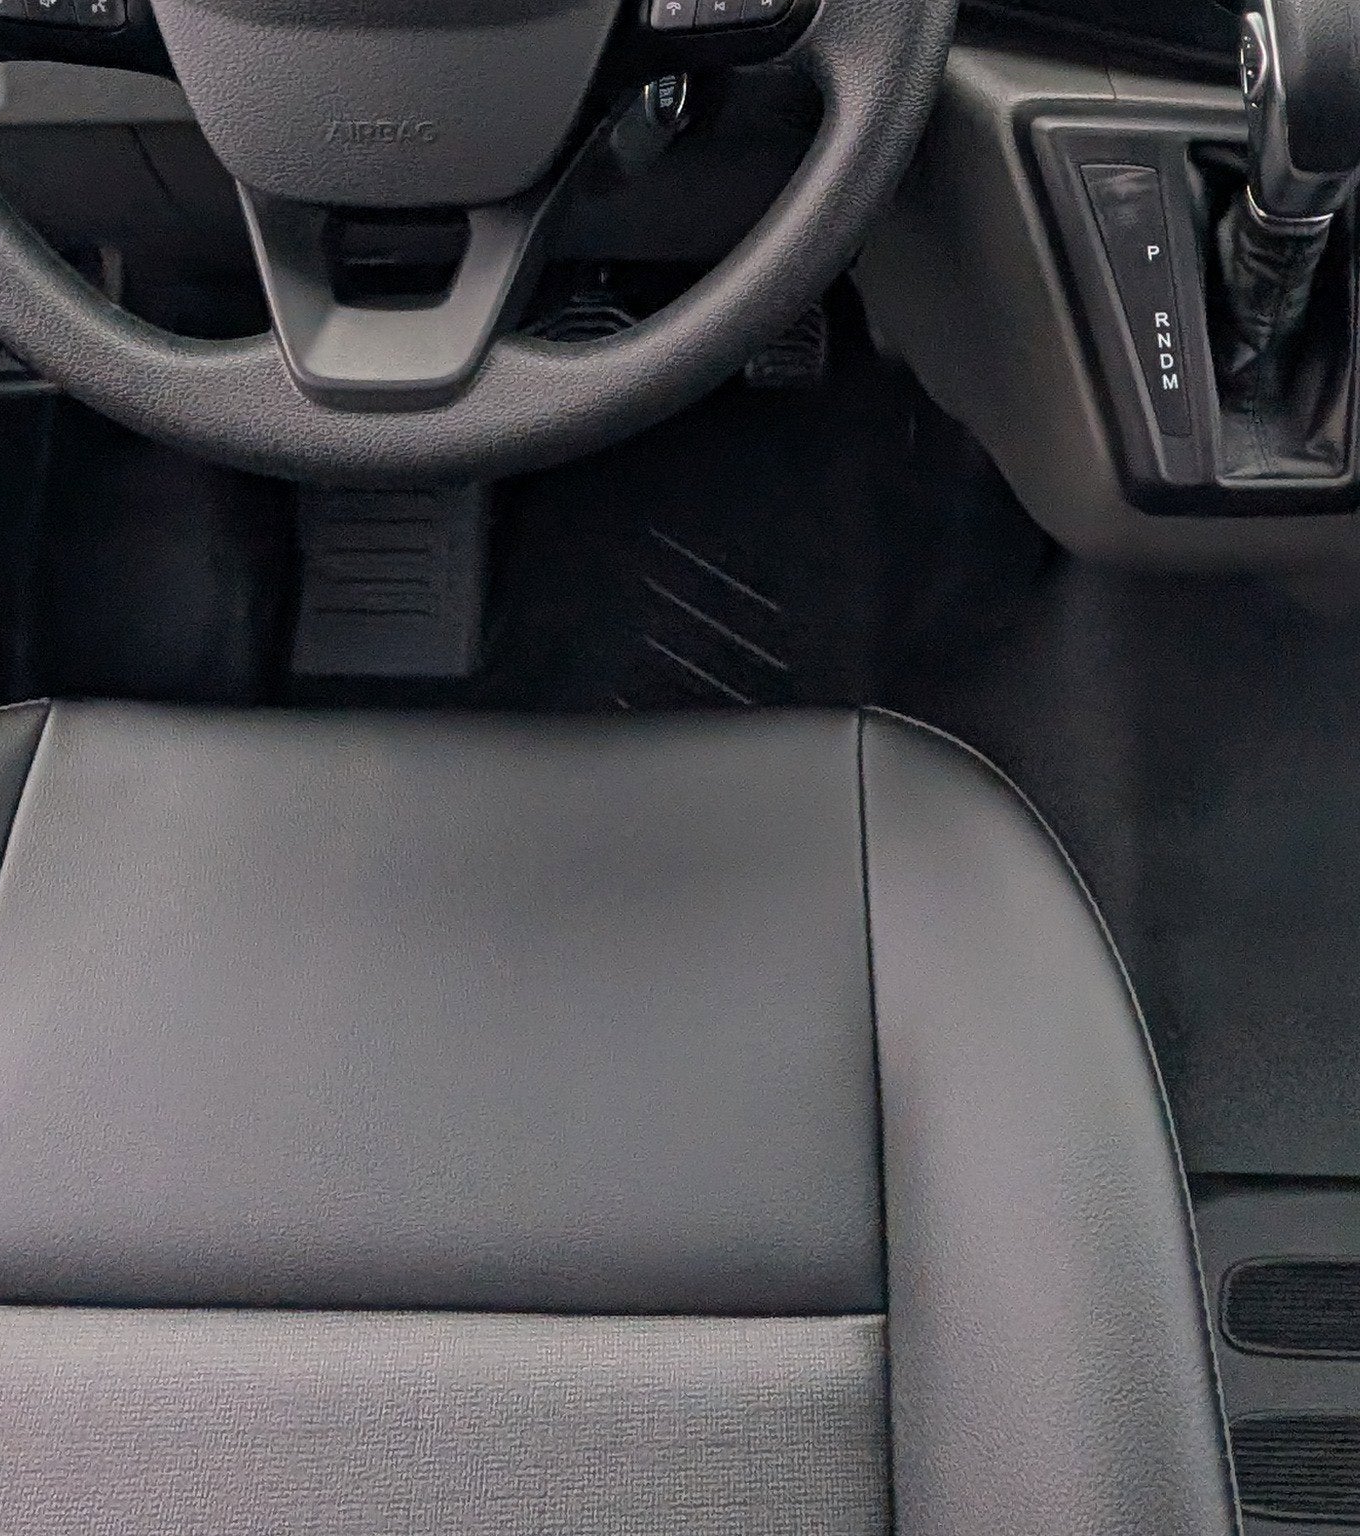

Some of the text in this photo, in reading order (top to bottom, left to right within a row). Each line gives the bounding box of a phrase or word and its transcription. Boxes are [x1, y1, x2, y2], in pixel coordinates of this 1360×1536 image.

[1147, 244, 1161, 261] P
[1154, 311, 1170, 327] R
[1157, 332, 1171, 348] N
[1160, 353, 1174, 368] D
[1162, 374, 1179, 390] M
